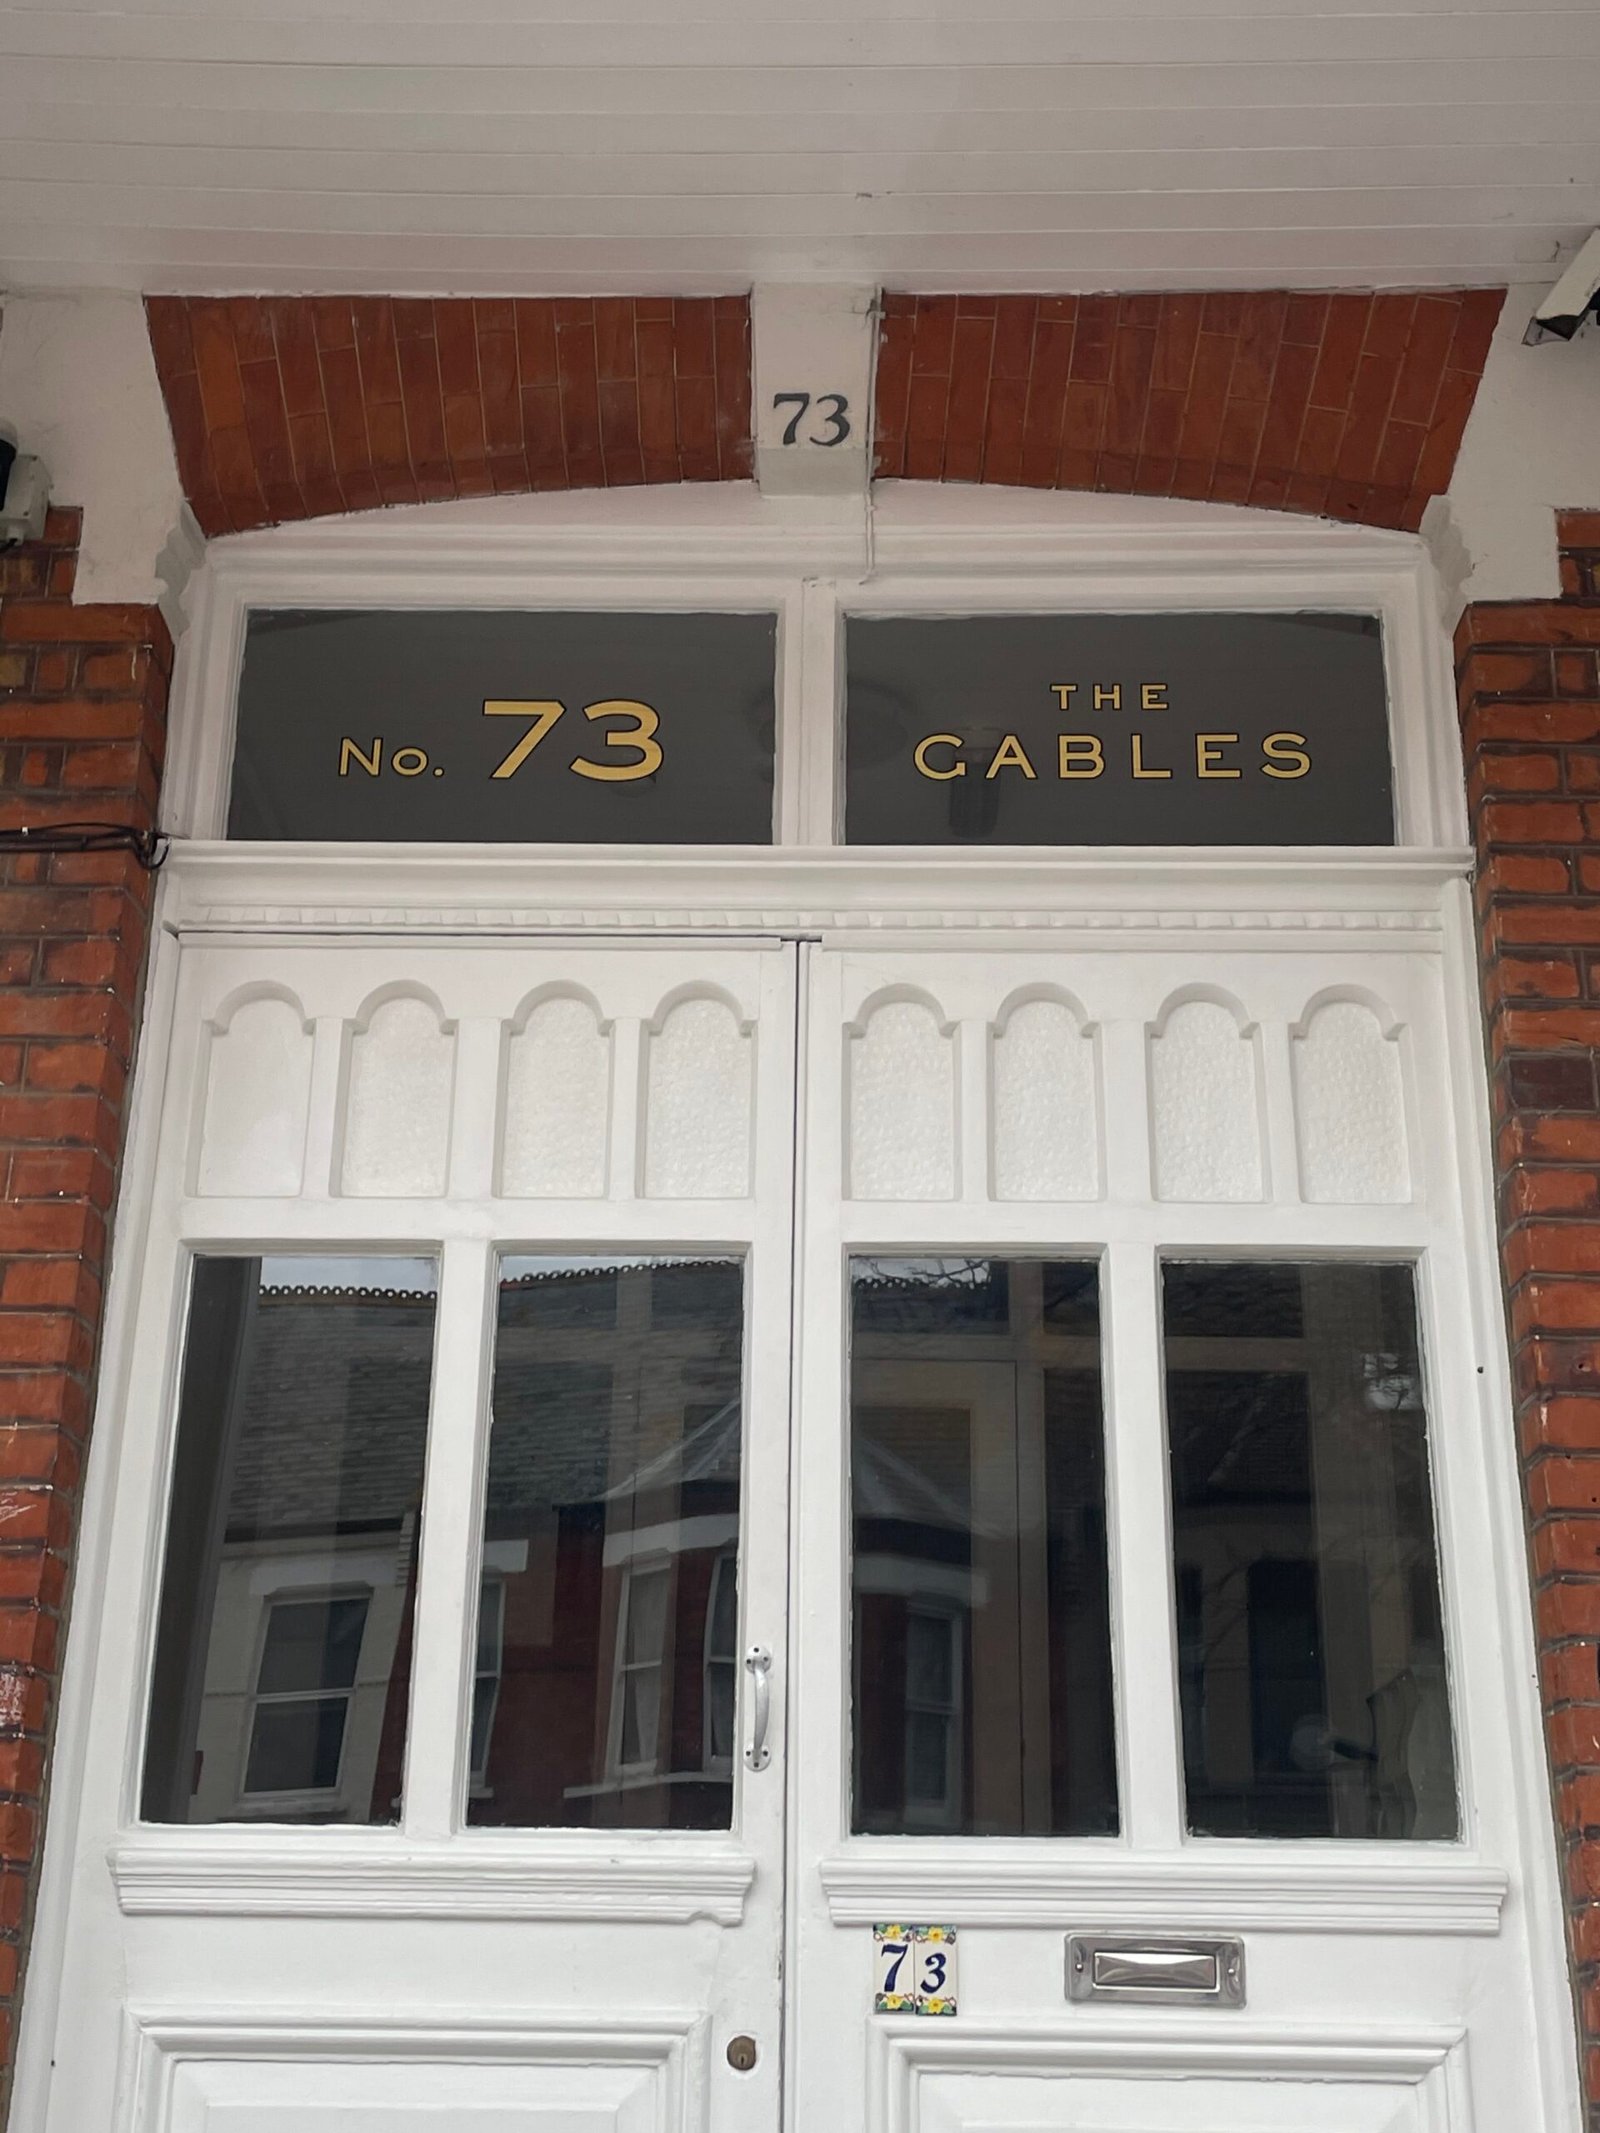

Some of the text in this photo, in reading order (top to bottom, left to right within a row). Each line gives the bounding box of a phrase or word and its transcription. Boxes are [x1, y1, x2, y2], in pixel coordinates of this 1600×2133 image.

[773, 393, 850, 446] 73
[1050, 683, 1170, 711] THE
[338, 697, 664, 782] No. 73
[913, 731, 1313, 781] GABLES
[880, 1943, 947, 1994] 73
